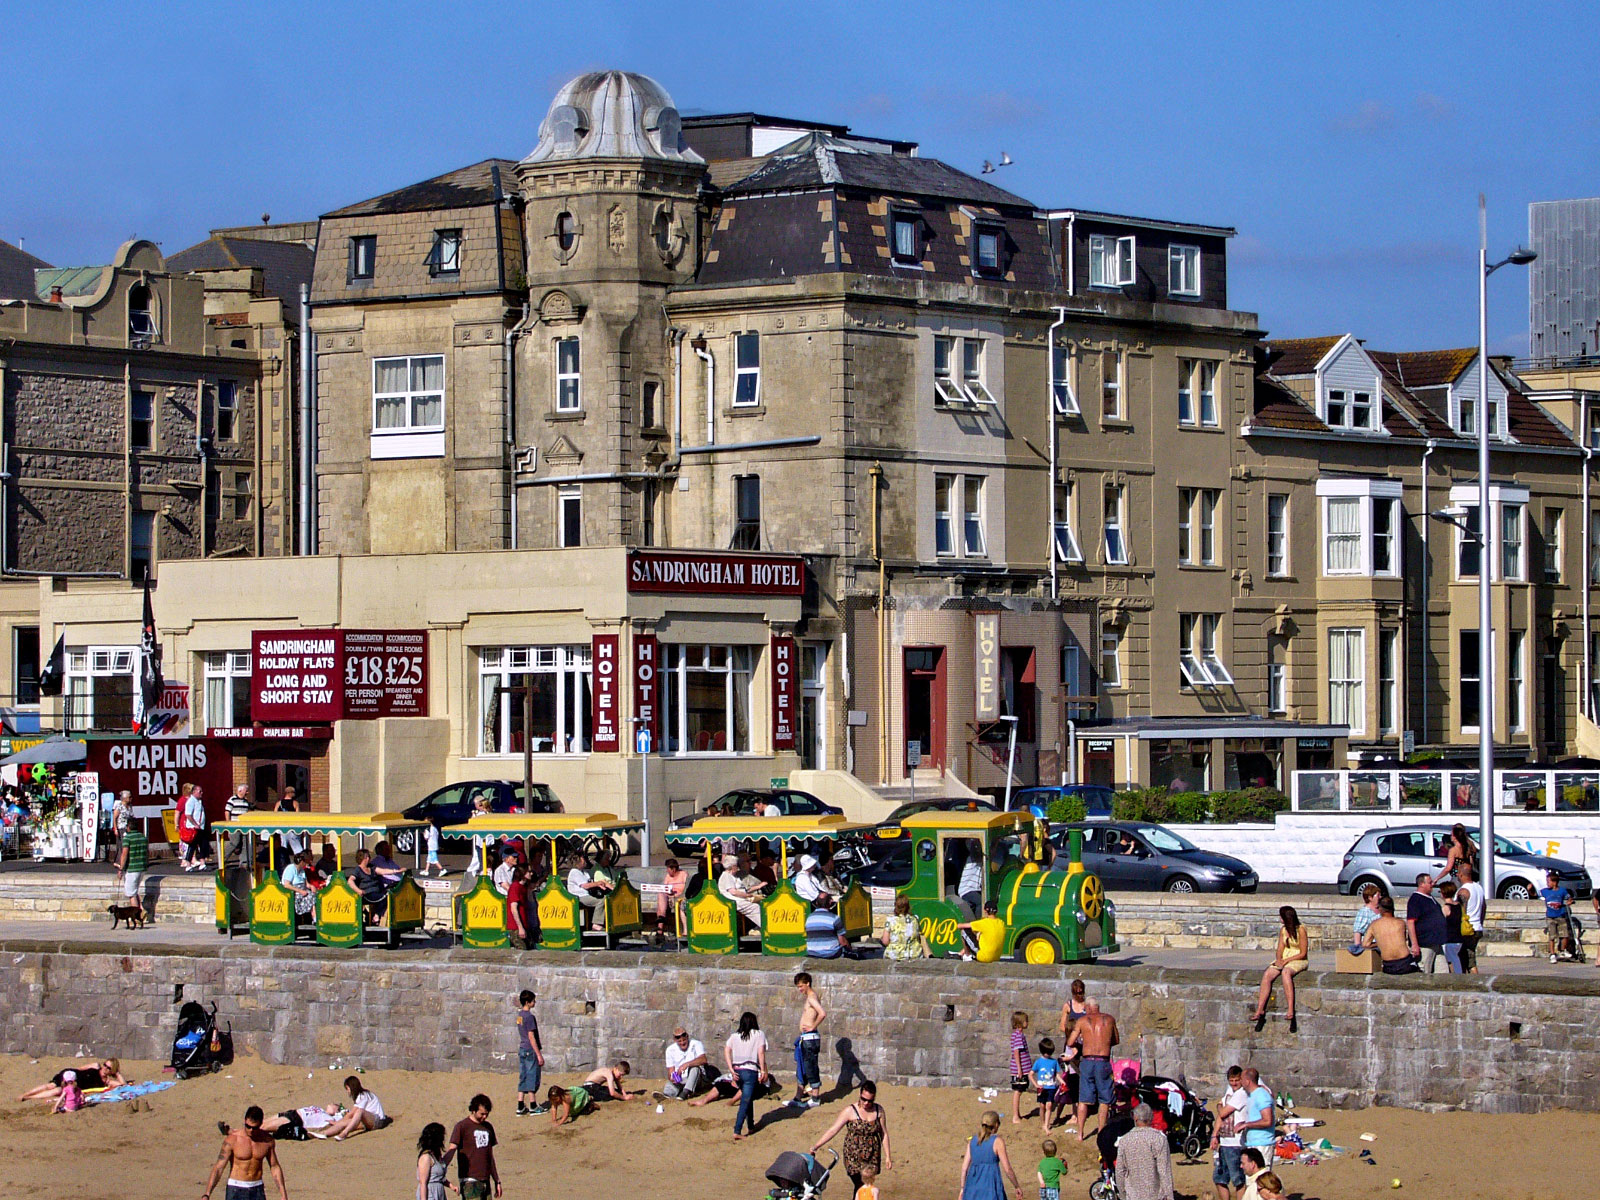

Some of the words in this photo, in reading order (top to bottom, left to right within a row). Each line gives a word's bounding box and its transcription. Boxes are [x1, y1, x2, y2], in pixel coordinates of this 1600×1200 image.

[632, 560, 745, 584] SANDRINGHAM
[751, 564, 800, 586] HOTEL
[260, 640, 335, 654] SANDRINGHAM
[259, 658, 300, 669] HOLIDAY
[303, 657, 335, 669] FLATS
[345, 656, 383, 685] £18
[385, 656, 423, 685] £25
[980, 621, 994, 712] HOTEL
[266, 675, 299, 688] LONG
[302, 675, 327, 688] AND
[345, 690, 358, 698] PER
[358, 690, 384, 698] PERSON
[598, 644, 613, 724] HOTEL
[638, 644, 653, 741] HOTE
[777, 646, 789, 724] HOTEL
[156, 691, 189, 709] ROCK
[260, 690, 300, 704] SHORT
[303, 690, 333, 704] STAY
[213, 728, 240, 737] CHAPLINS
[241, 728, 254, 737] BAR
[263, 728, 290, 737] CHAPLINS
[291, 728, 304, 737] BAR
[109, 744, 207, 770] CHAPLINS
[77, 776, 97, 784] ROCK
[138, 771, 179, 796] BAR
[85, 803, 95, 858] ROCK
[919, 917, 958, 945] WR
